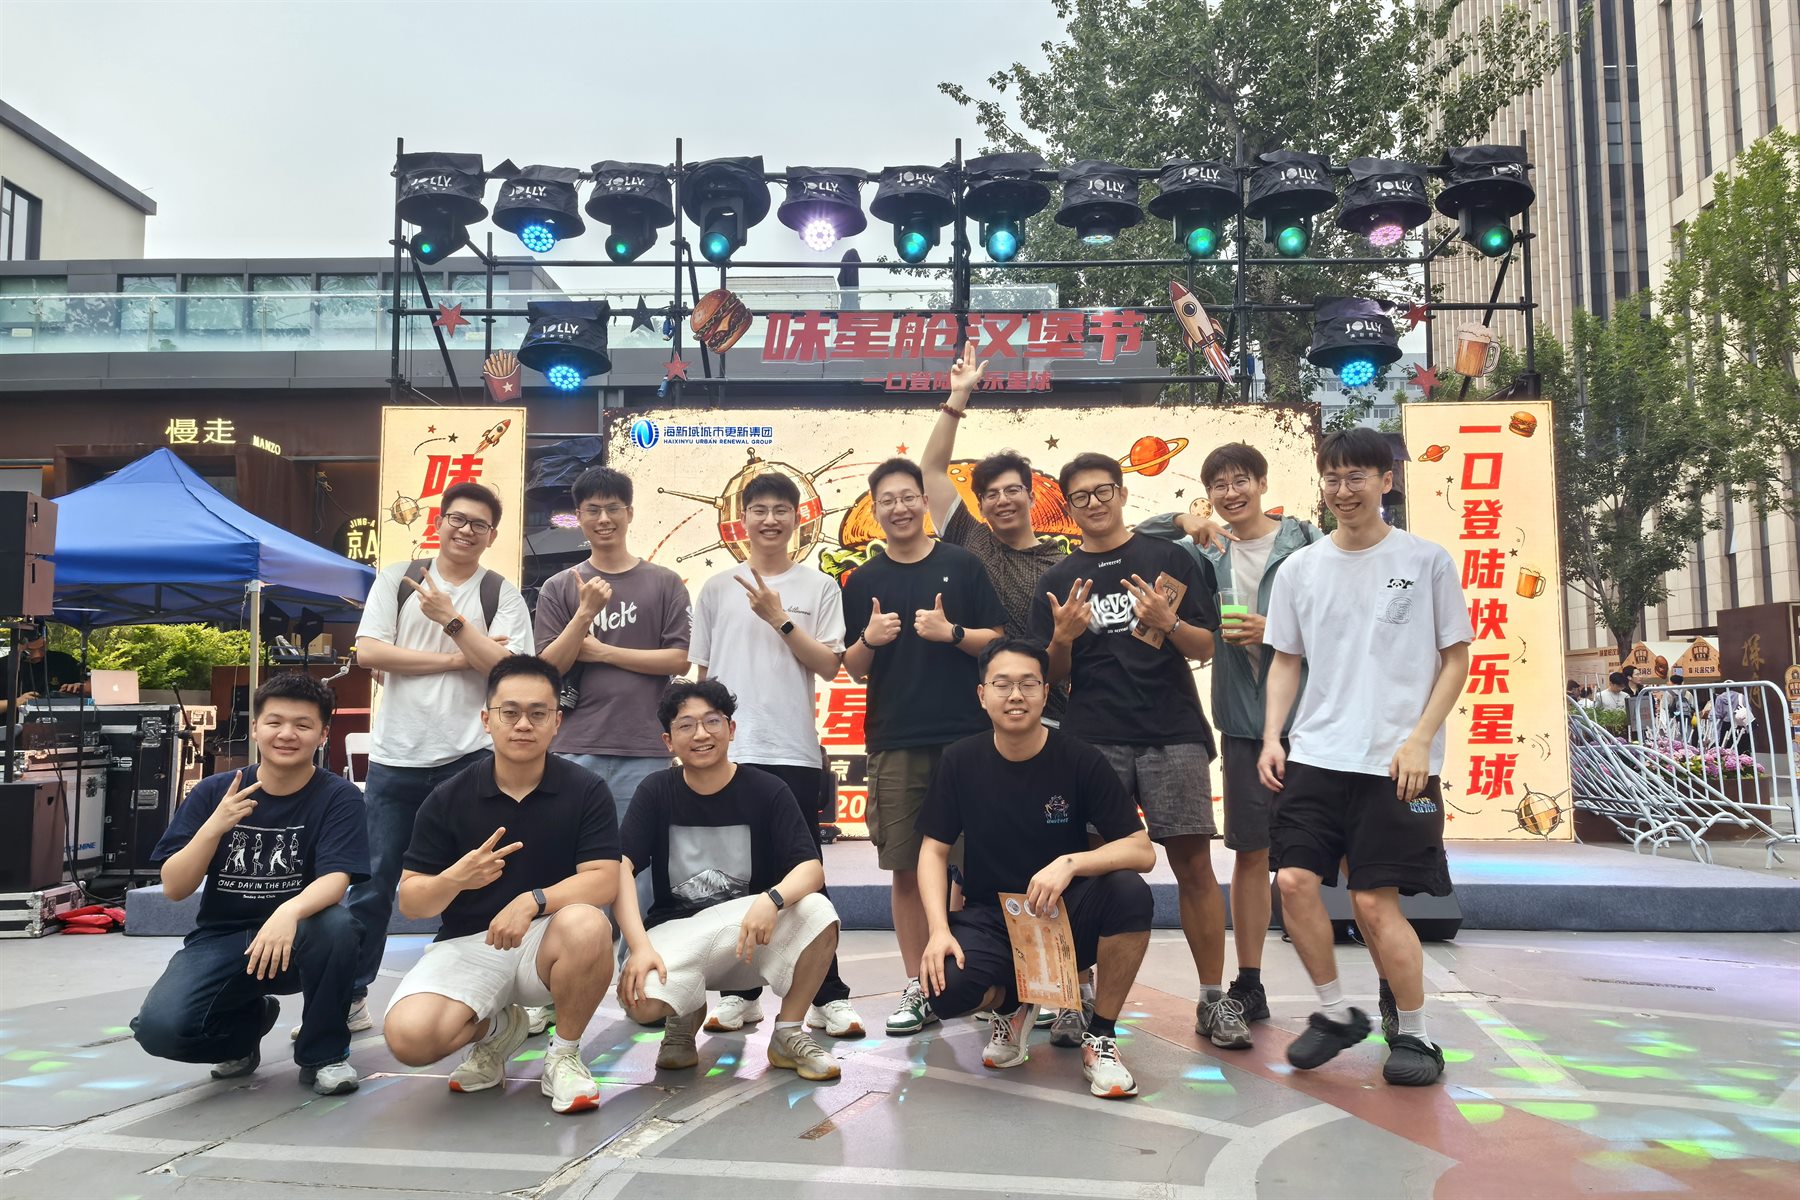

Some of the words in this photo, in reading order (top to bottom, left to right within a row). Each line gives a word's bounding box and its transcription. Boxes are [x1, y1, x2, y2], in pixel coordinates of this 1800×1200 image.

[863, 371, 1054, 391] 一口登陆乐星球
[165, 417, 236, 444] 慢走
[663, 426, 773, 437] 海新域城市更新集团
[252, 434, 281, 455] MANZO
[350, 517, 376, 529] JING-A
[1459, 425, 1519, 800] 一口登陆快乐星球
[238, 881, 253, 889] DAY
[281, 880, 303, 889] PARK
